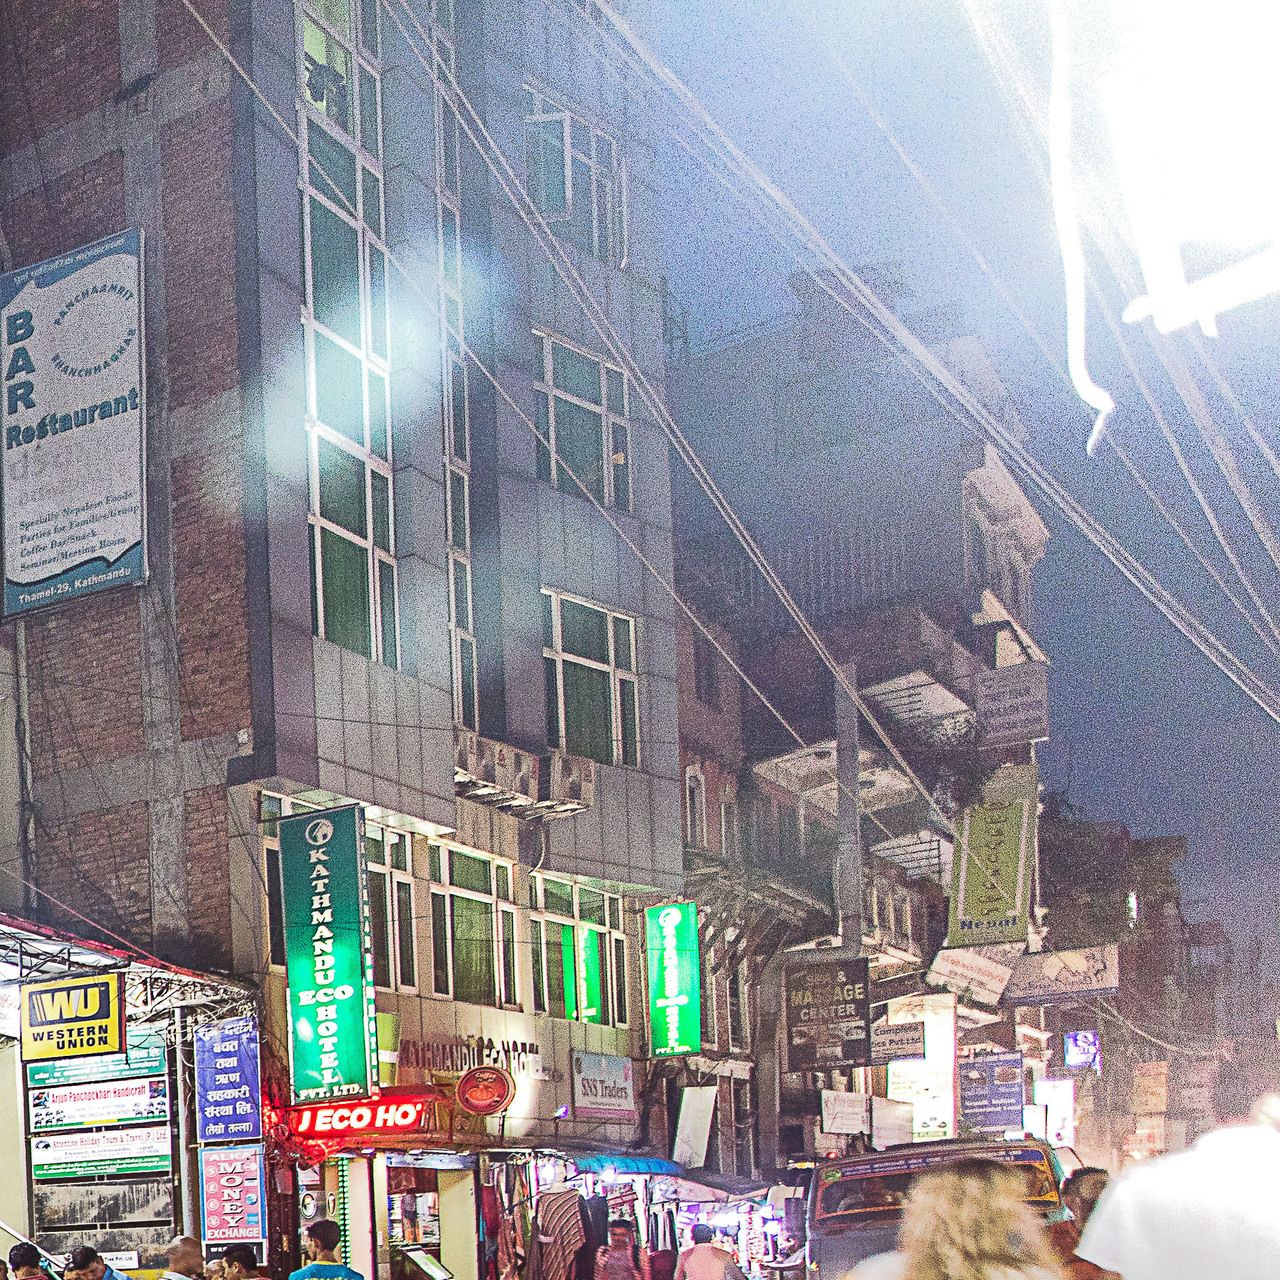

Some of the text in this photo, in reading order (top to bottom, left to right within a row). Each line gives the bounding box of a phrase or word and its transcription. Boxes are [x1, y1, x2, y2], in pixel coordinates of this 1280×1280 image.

[5, 310, 36, 415] BAR
[6, 387, 139, 450] Restaurant
[19, 567, 131, 604] Thamel-29, Kathmandu
[308, 848, 338, 986] KATHMANDU
[41, 986, 101, 1021] WU
[297, 985, 355, 1007] ECO
[800, 1004, 856, 1020] CENTER
[32, 1024, 109, 1042] WESTERN
[56, 1035, 109, 1050] UNION
[315, 1004, 340, 1084] HOTEL
[215, 1056, 238, 1070] तथा
[207, 1086, 250, 1102] सहकारी
[299, 1083, 364, 1102] PVT. LTD.
[599, 1079, 628, 1099] Traders
[315, 1106, 372, 1132] ECO
[208, 1150, 251, 1162] ALKA
[217, 1161, 245, 1228] MONEY
[207, 1228, 260, 1239] EXCHANGE
